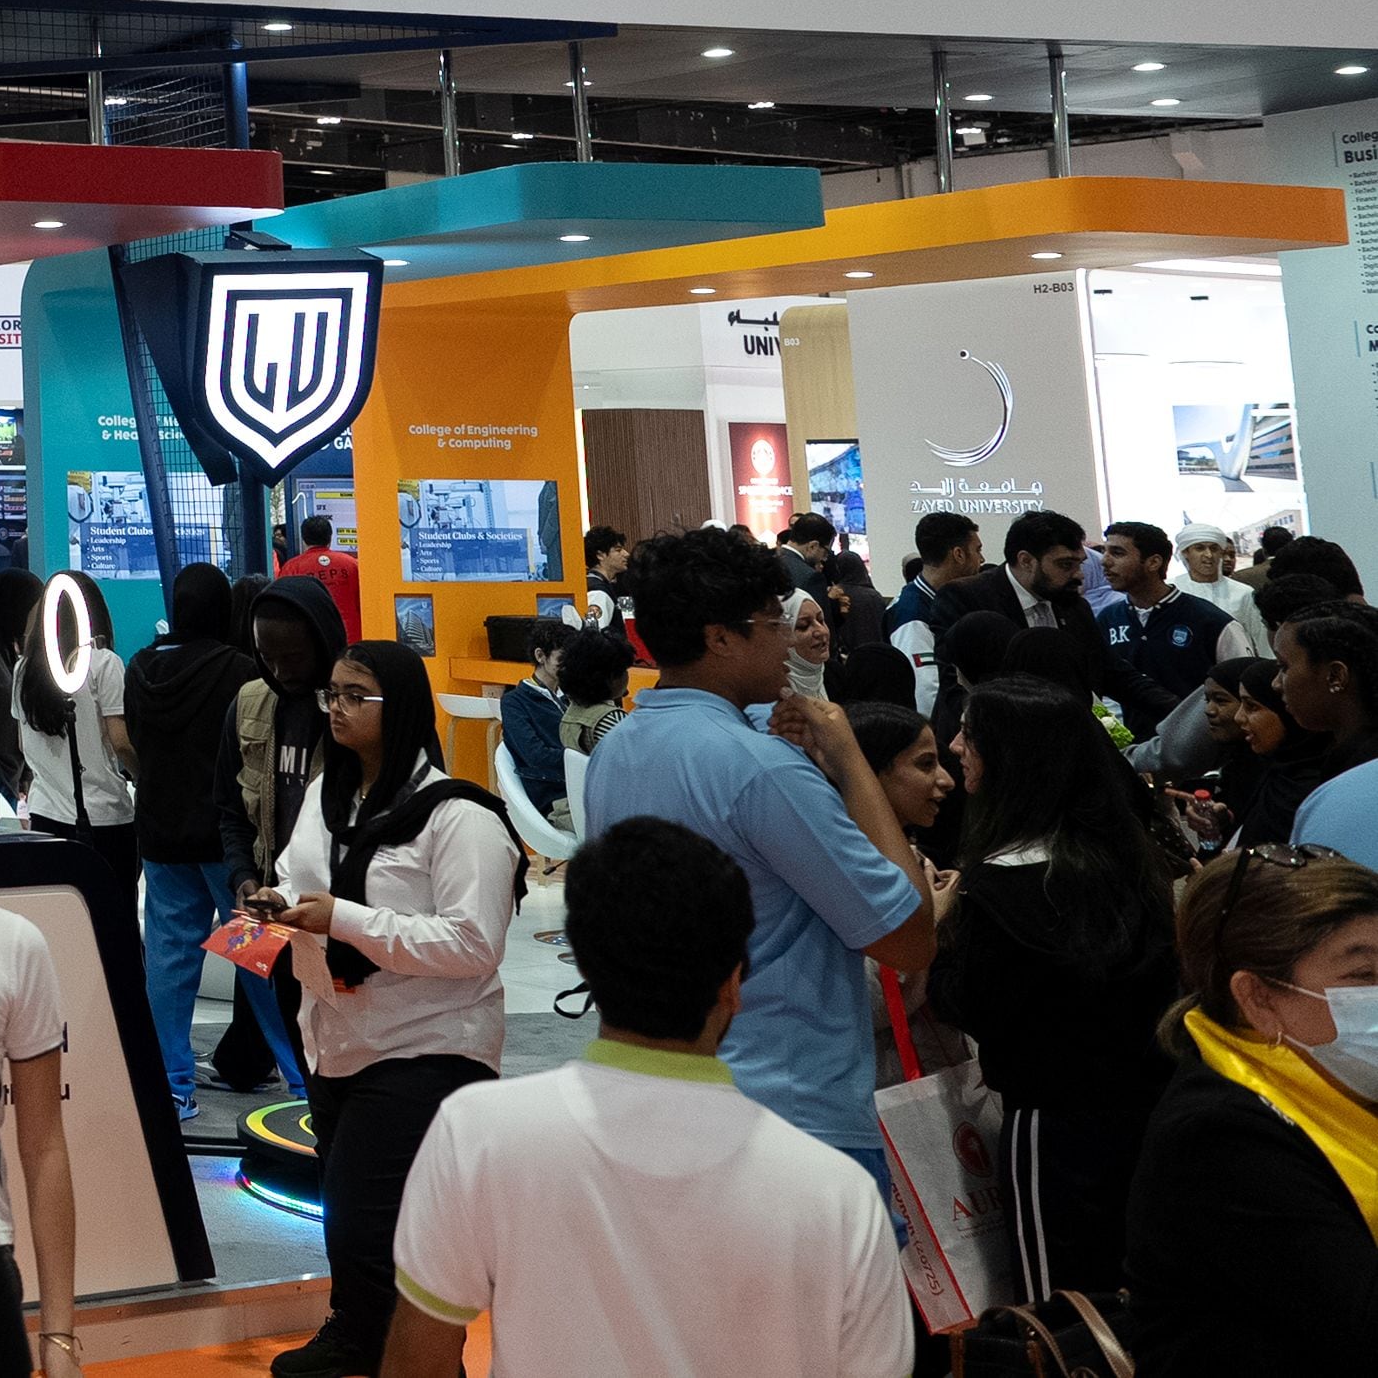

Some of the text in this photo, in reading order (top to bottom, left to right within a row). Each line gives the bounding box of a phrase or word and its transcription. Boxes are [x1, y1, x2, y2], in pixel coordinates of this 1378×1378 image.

[1344, 144, 1378, 164] Busi
[1033, 281, 1074, 294] H2-B03
[98, 415, 137, 428] Colleg
[102, 430, 112, 440] &
[408, 424, 538, 438] College of Engineering
[437, 438, 512, 450] & Computing
[909, 477, 1043, 498] جامعة زايد
[911, 498, 1044, 514] ZAYED UNIVERSITY
[90, 526, 153, 536] Student Clubs
[418, 531, 523, 541] Student Clubs & Societies
[90, 537, 127, 546] Leadership
[418, 541, 452, 549] Leadership
[90, 545, 105, 553] Arts
[90, 553, 113, 562] Sports
[420, 557, 440, 565] Sports
[91, 562, 116, 570] Culture
[420, 565, 443, 573] Culture
